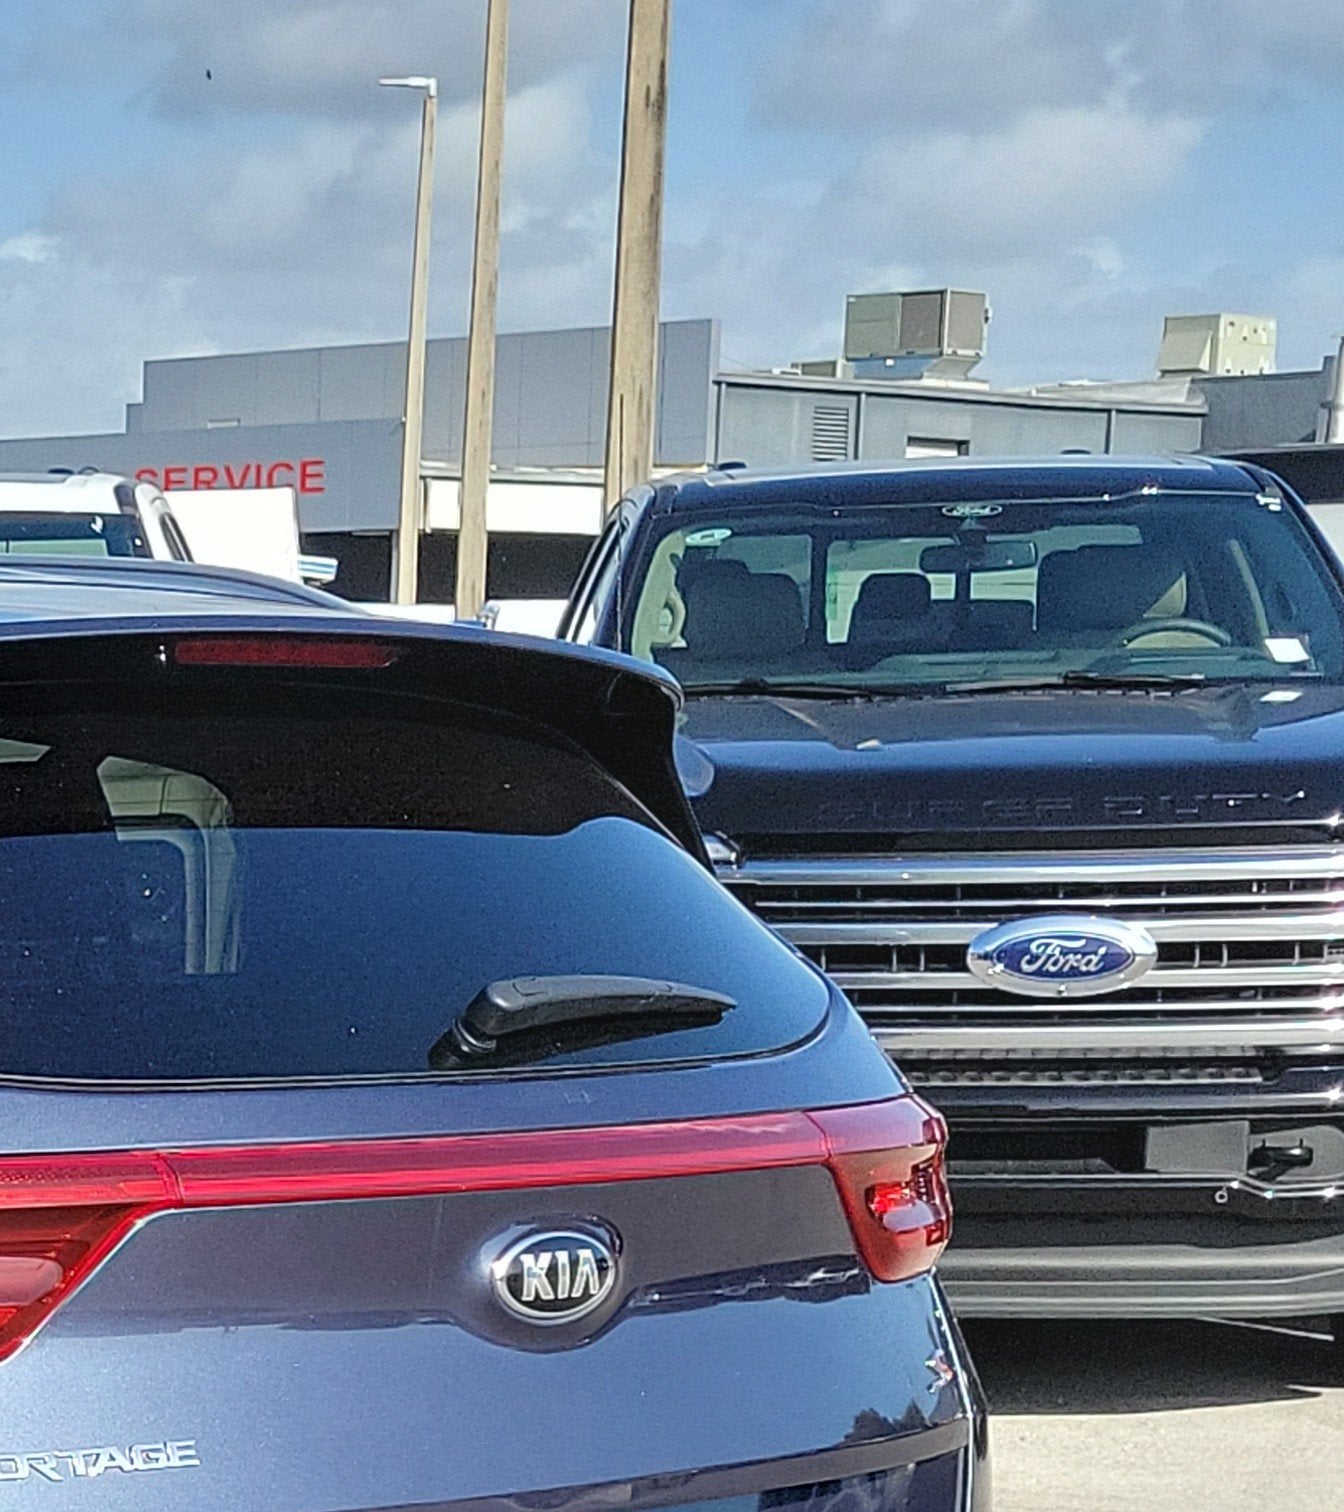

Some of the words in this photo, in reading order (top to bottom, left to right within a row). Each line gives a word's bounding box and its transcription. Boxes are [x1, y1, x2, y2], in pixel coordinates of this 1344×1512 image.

[1104, 788, 1308, 818] DUTY
[1018, 936, 1106, 974] Ford
[519, 1248, 600, 1301] KIA
